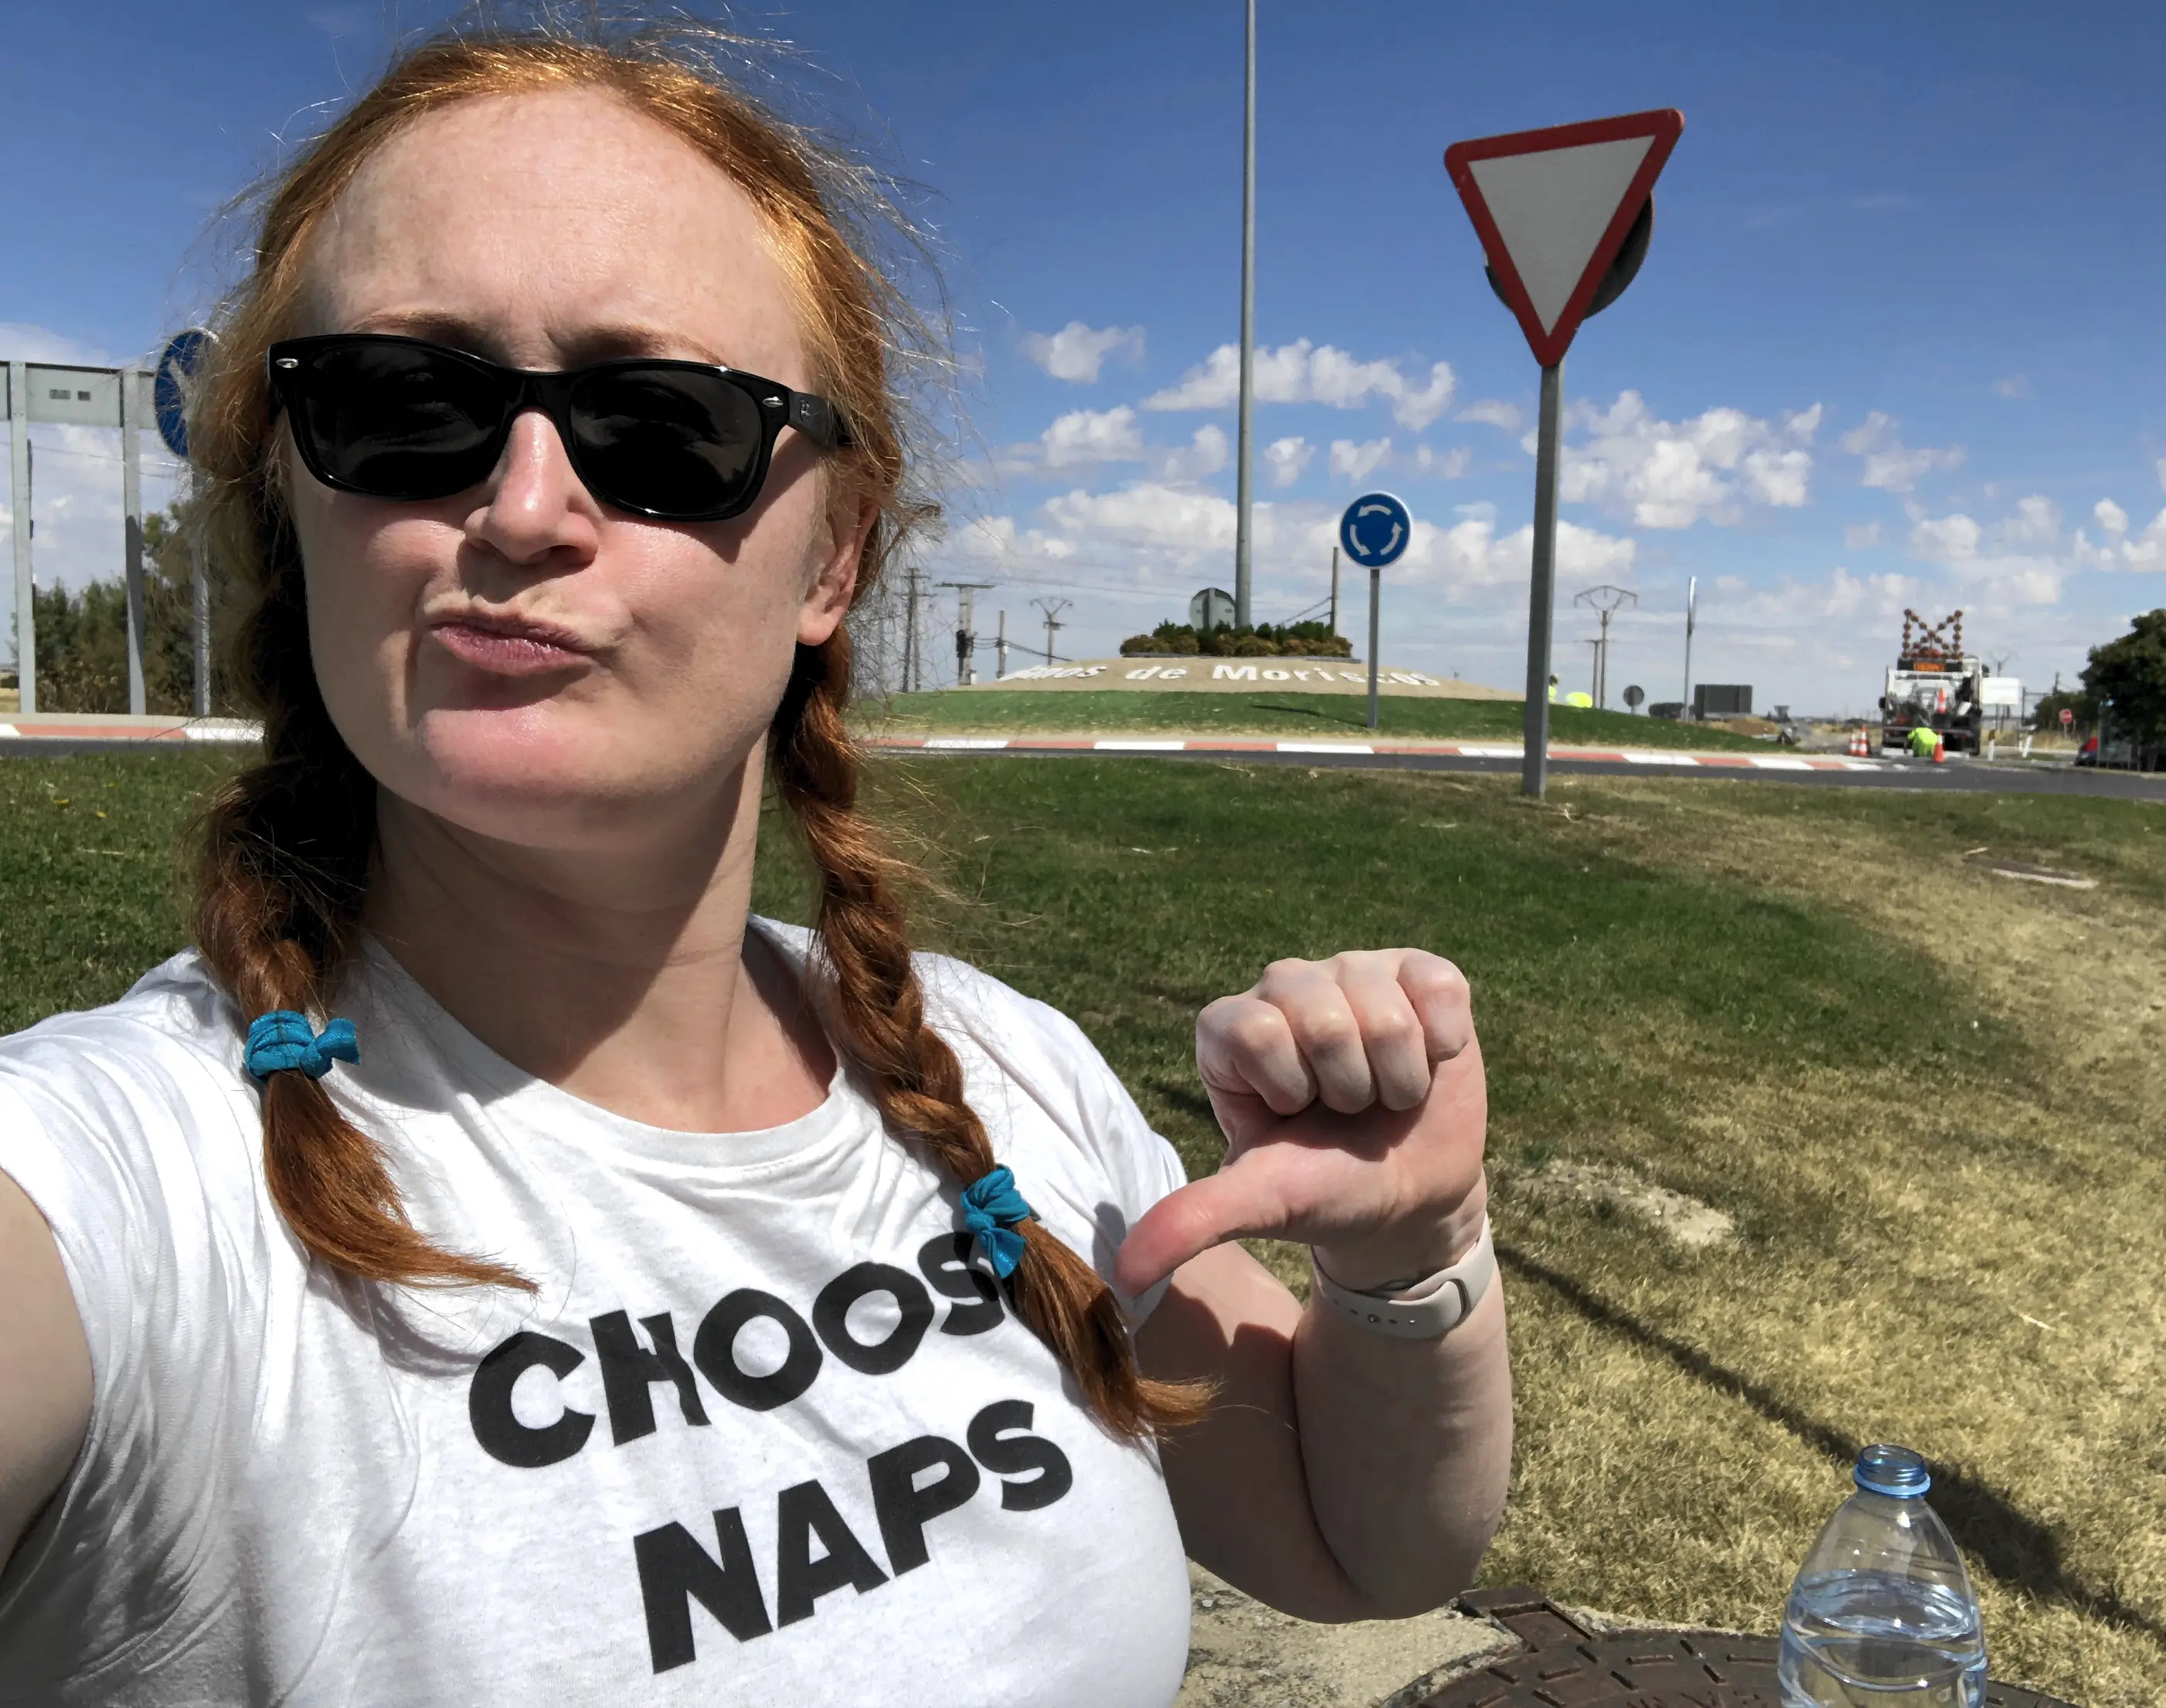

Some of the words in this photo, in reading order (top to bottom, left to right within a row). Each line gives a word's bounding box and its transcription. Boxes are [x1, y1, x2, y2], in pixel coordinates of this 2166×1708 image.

[1125, 665, 1187, 681] de
[469, 1230, 1006, 1468] CHOOS
[633, 1399, 1073, 1675] NAPS
